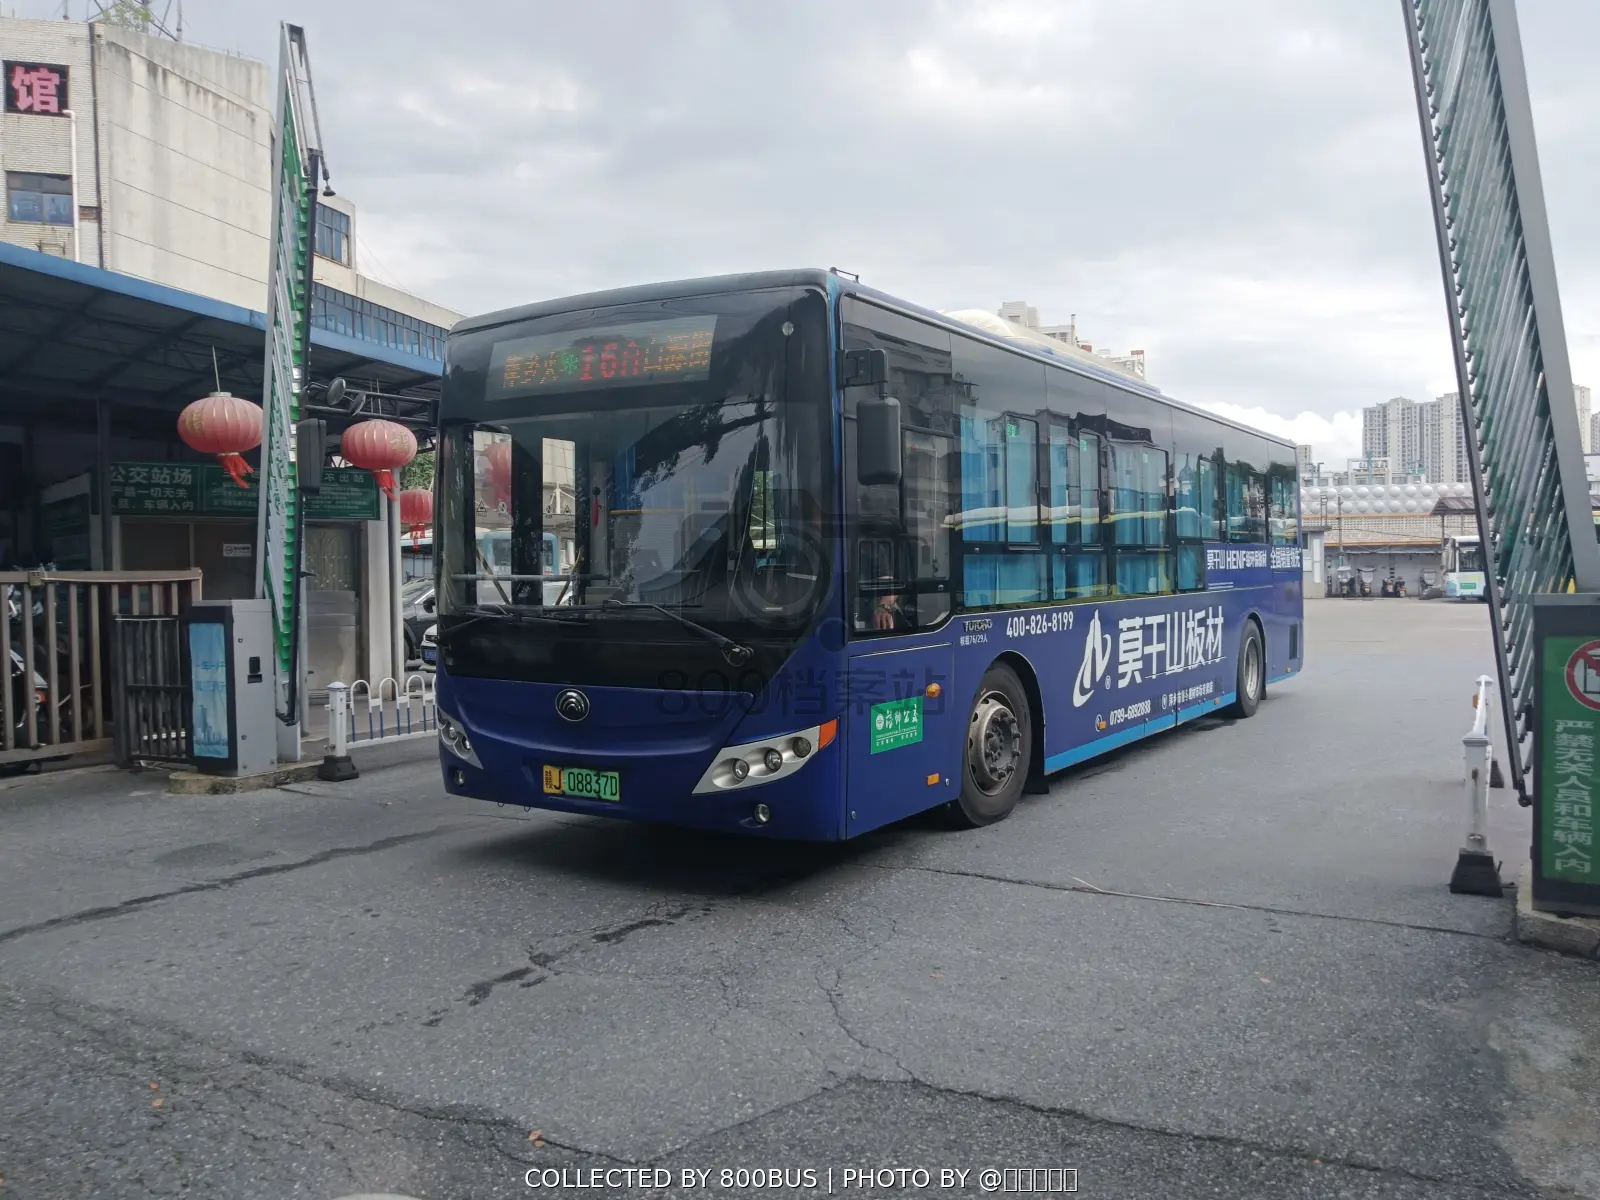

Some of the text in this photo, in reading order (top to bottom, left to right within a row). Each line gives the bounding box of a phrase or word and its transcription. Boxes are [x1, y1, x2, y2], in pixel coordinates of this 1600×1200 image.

[11, 64, 60, 113] 馆
[110, 465, 193, 485] 公交站场
[111, 498, 194, 511] 员、车辆入内
[1006, 610, 1074, 638] 400-826-8199
[1118, 605, 1224, 689] 莫干山板材
[1554, 719, 1595, 873] 严禁无关人员和车辆入内
